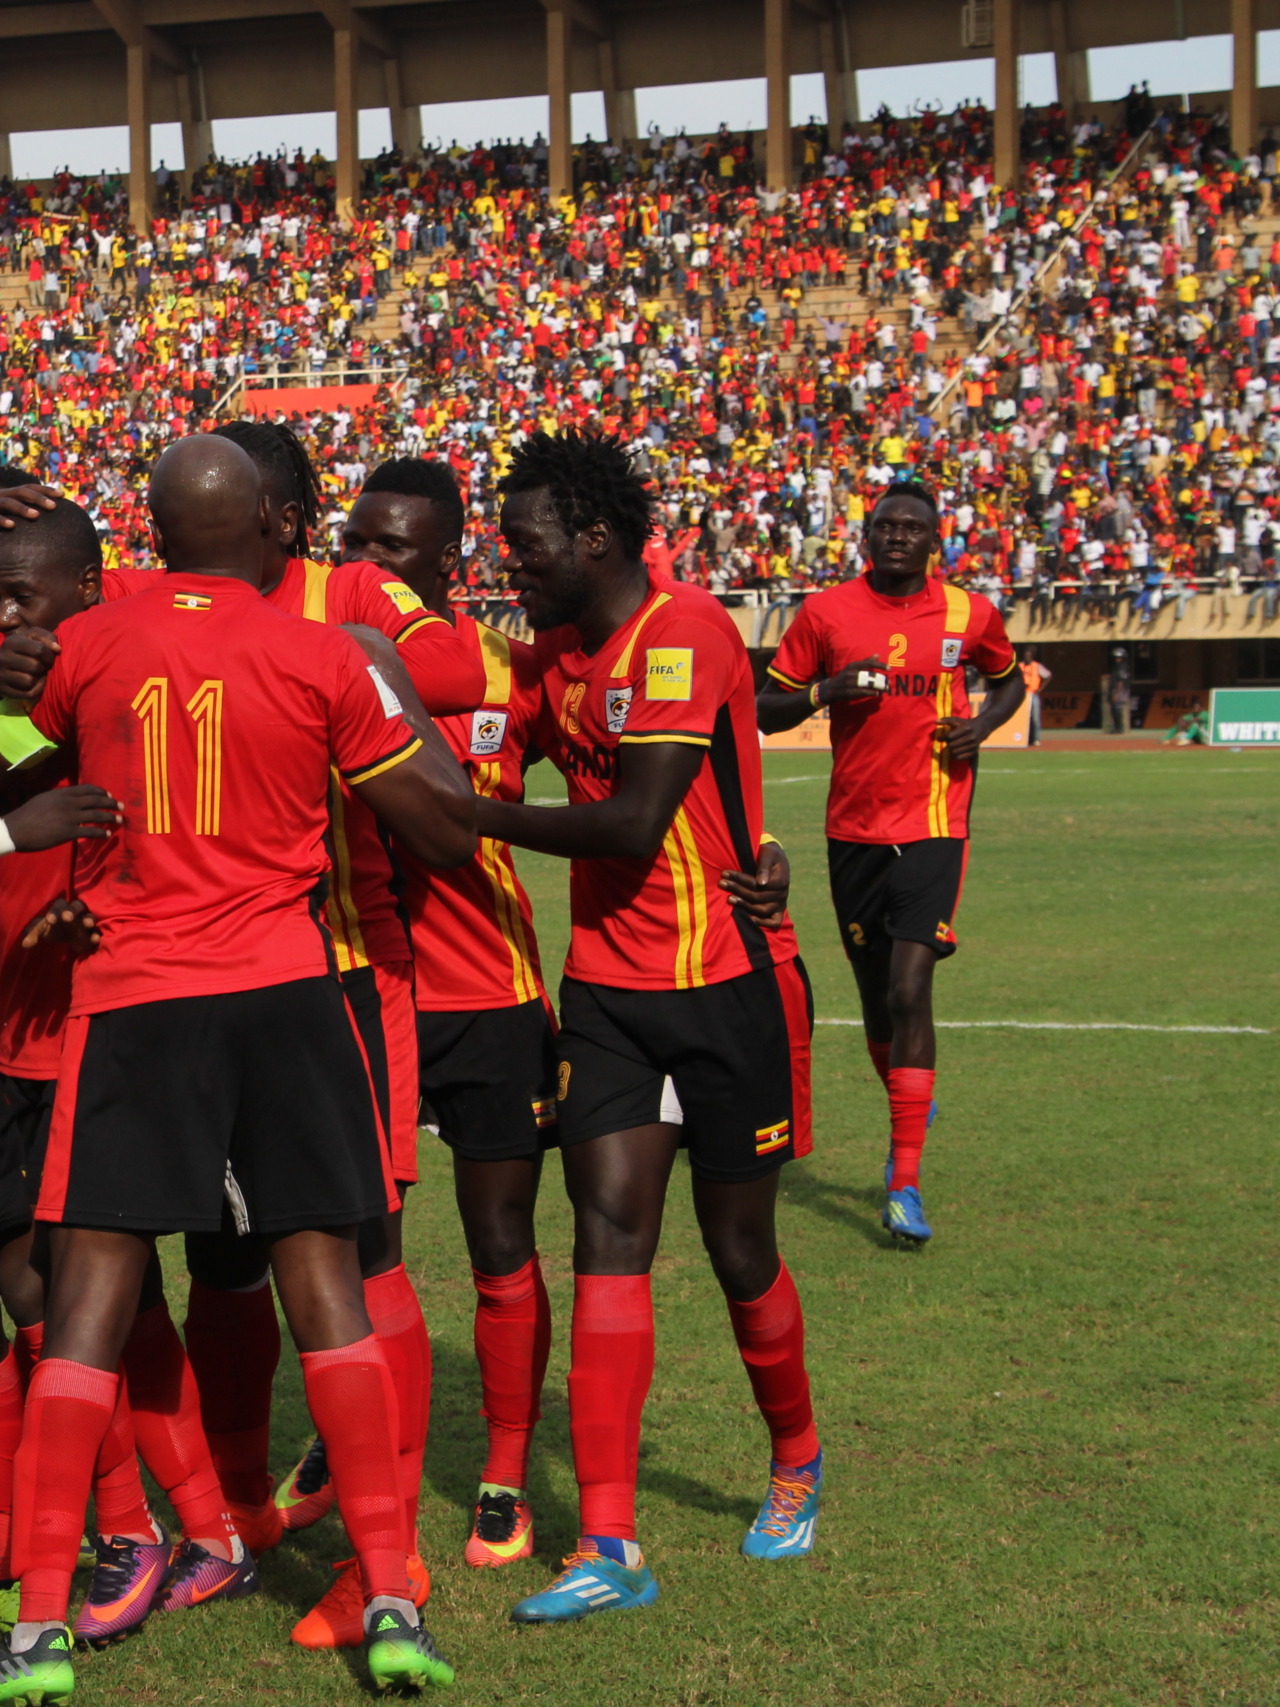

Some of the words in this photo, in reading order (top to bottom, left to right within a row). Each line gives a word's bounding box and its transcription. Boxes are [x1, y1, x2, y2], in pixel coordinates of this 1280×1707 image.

[888, 633, 907, 667] 2
[649, 665, 674, 675] FIFA
[560, 682, 586, 734] 13
[1219, 722, 1280, 741] WHIT
[130, 677, 223, 836] 11
